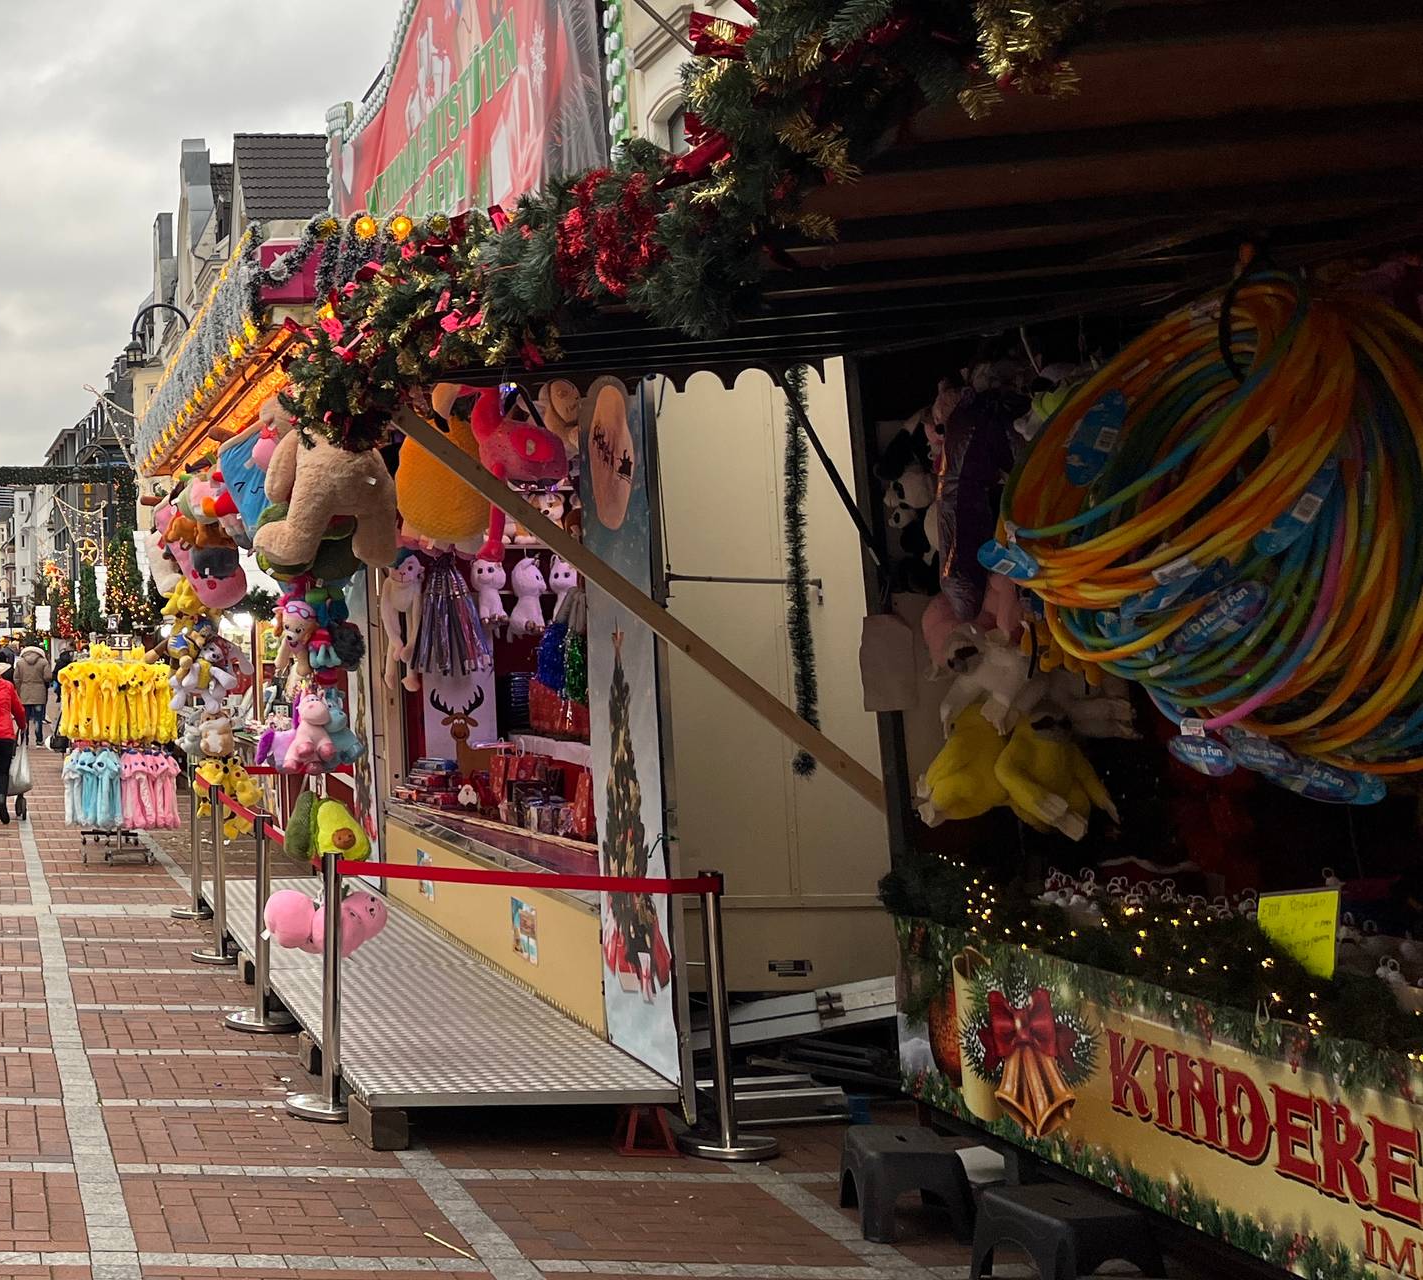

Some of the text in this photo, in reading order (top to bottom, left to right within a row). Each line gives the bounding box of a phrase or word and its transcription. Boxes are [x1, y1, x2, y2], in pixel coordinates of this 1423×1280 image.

[365, 7, 518, 219] WEIHNACHTSTÜTEN
[1227, 587, 1249, 606] Fun
[114, 636, 129, 647] 15
[1207, 745, 1223, 757] Fun
[1323, 773, 1345, 787] Fun
[1361, 1219, 1423, 1280] IM
